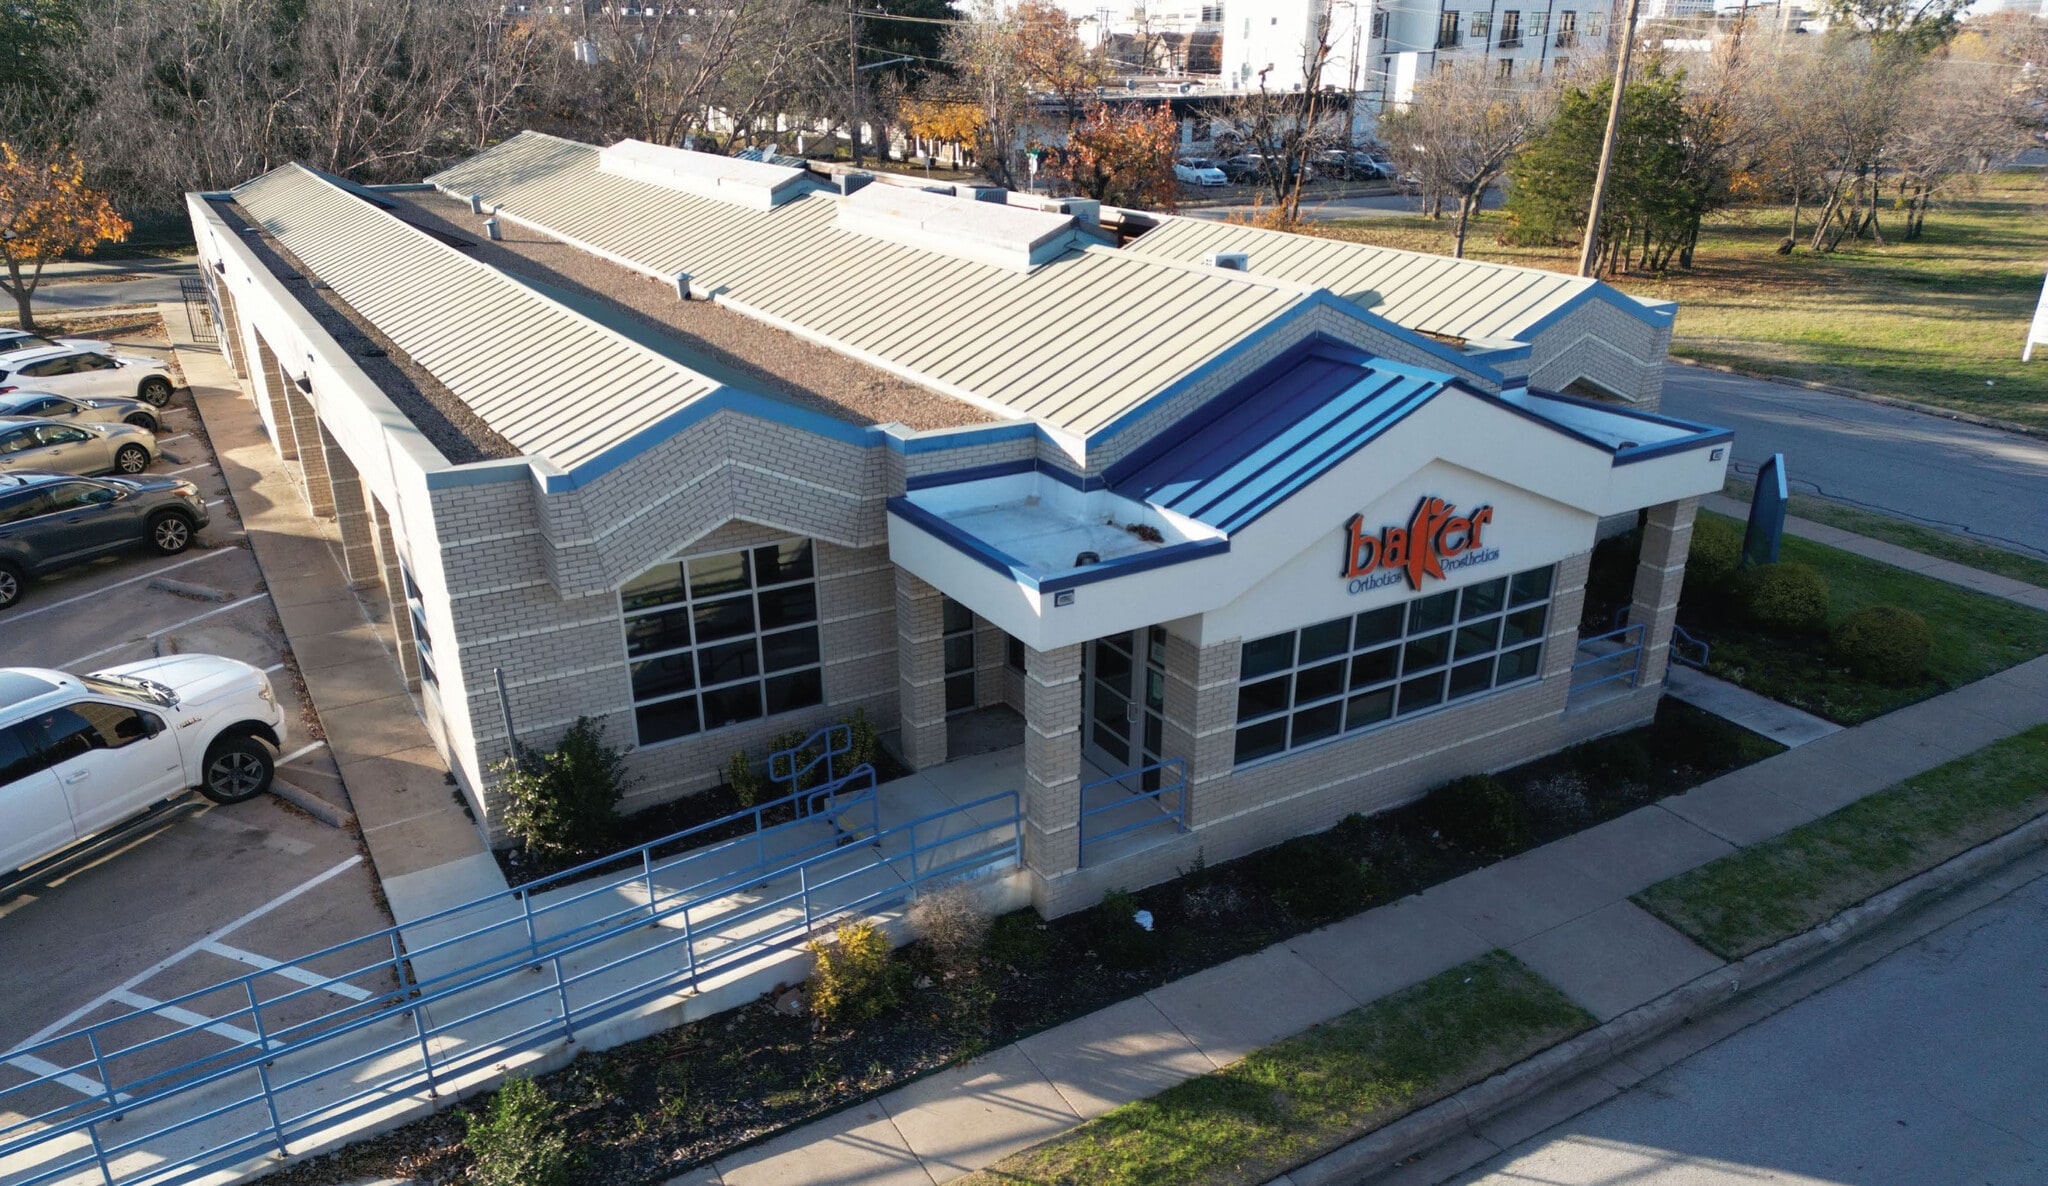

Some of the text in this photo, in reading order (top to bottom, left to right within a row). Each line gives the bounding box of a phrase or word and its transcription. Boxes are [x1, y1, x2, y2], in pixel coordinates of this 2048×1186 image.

[1343, 496, 1494, 592] baker
[1349, 548, 1499, 594] Orthotics Prosthetics
